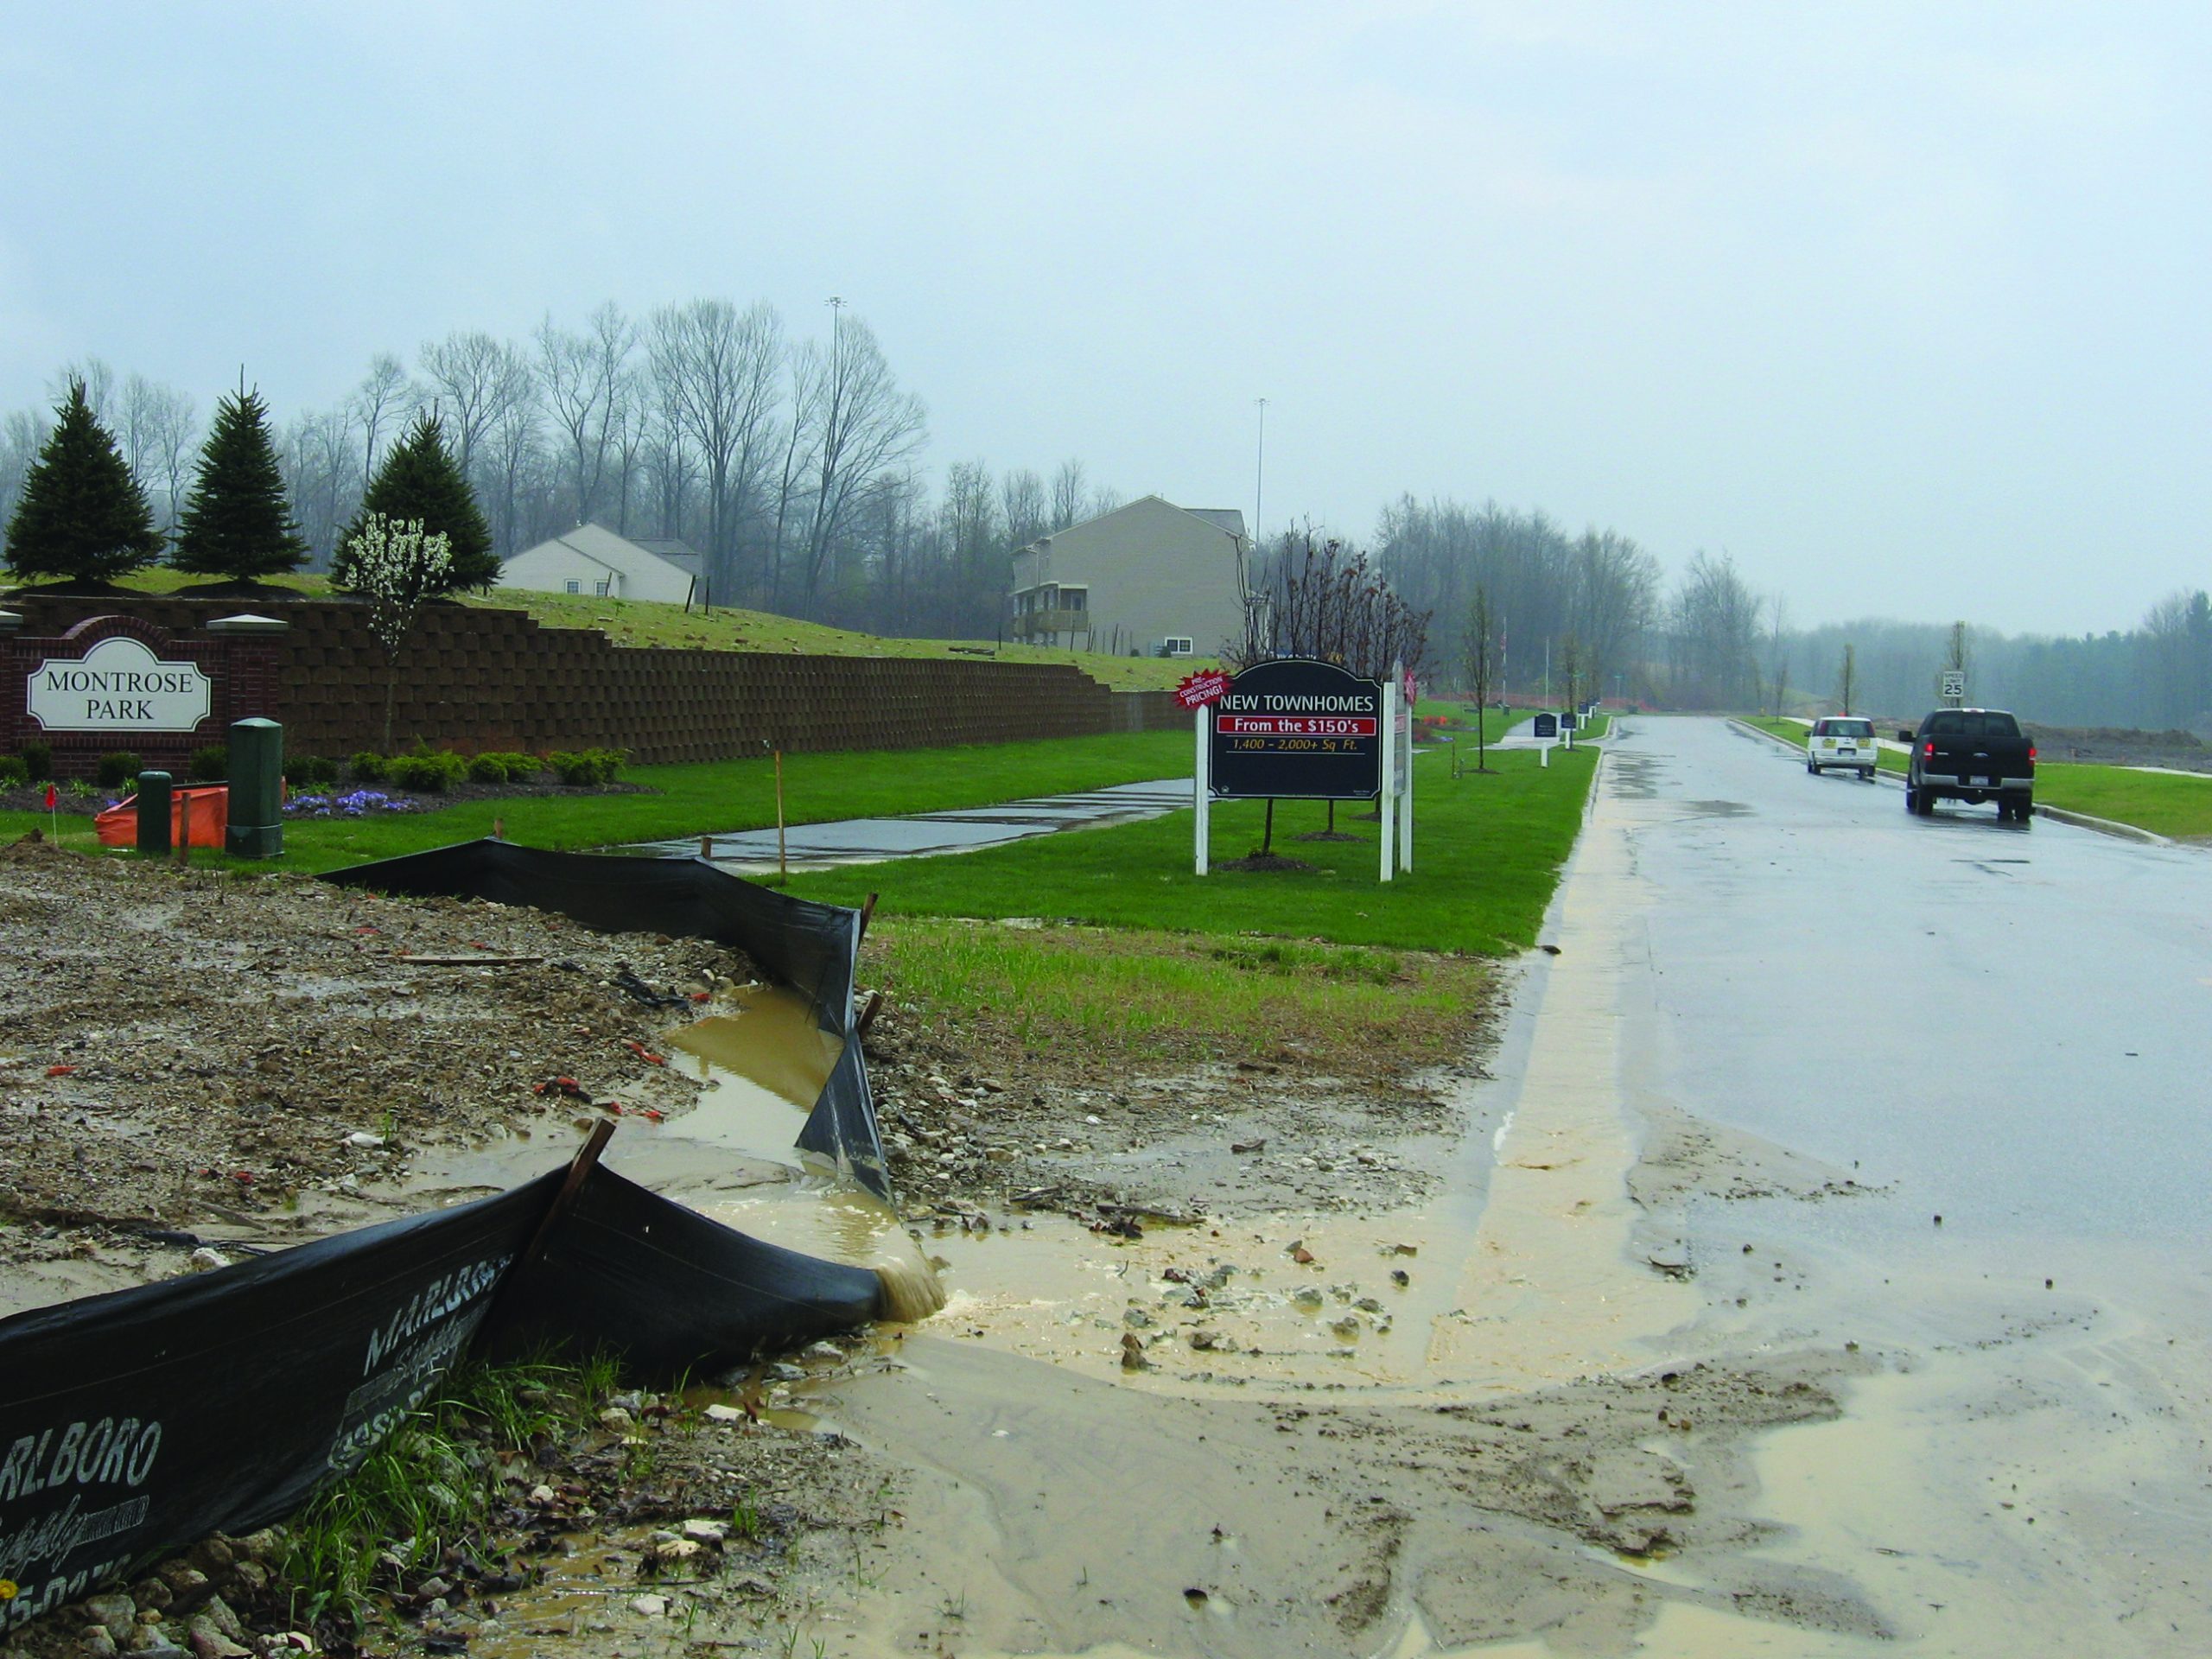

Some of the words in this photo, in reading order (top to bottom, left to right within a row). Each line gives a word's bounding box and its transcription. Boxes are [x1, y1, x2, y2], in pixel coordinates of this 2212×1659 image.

[47, 671, 194, 693] MONTROSE
[1944, 683, 1962, 695] 25
[1185, 684, 1224, 706] PRICING!
[1219, 695, 1259, 710] NEW
[1263, 695, 1374, 712] TOWNHOMES
[86, 699, 155, 720] PARK
[1235, 718, 1272, 732] From
[1278, 719, 1303, 732] the
[1307, 719, 1359, 733] $150's
[1233, 739, 1265, 750] 1,400
[1278, 739, 1318, 750] 2,000+
[1322, 739, 1336, 752] Sq
[1343, 740, 1357, 750] Ft.
